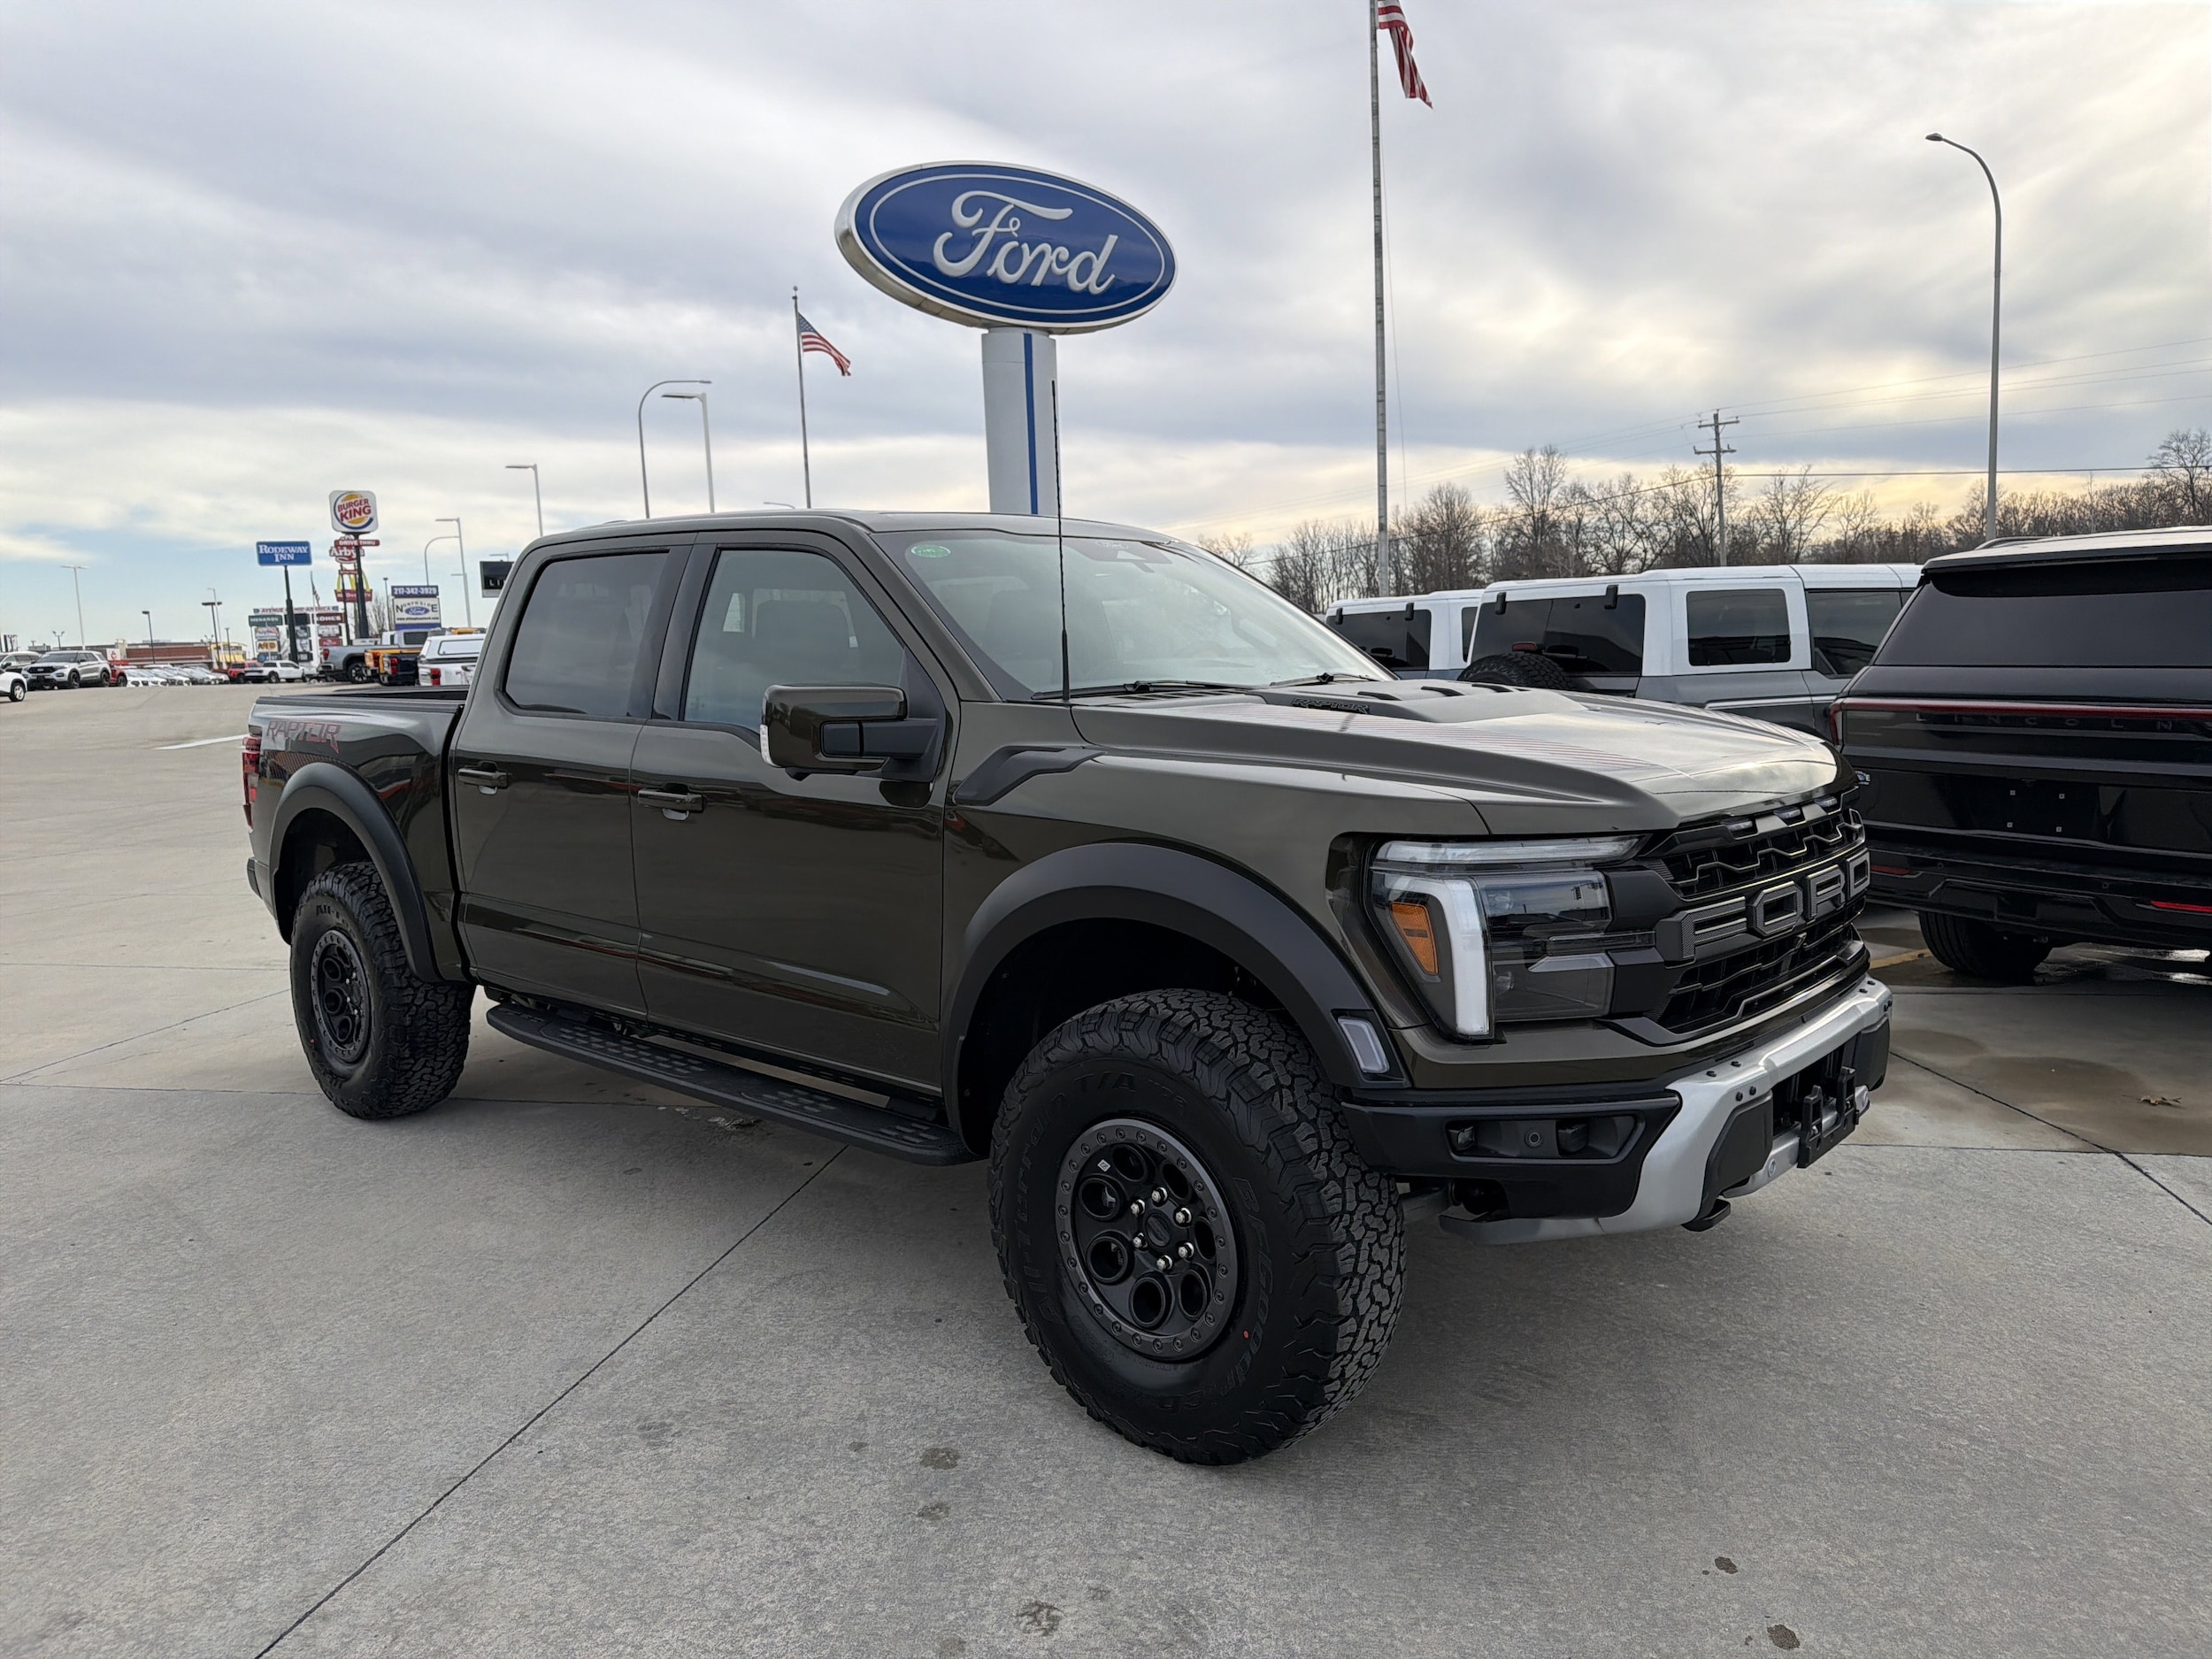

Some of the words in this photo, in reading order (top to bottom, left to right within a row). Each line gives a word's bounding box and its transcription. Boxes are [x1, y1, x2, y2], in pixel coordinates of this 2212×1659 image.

[933, 189, 1119, 296] Ford
[337, 498, 370, 512] BURGER
[339, 505, 372, 522] KING
[257, 544, 309, 554] RODEWAY
[330, 546, 365, 558] Arbys
[274, 553, 295, 563] INN
[1293, 698, 1368, 714] RAPTOR
[266, 720, 342, 754] RAPTOR
[1680, 847, 1870, 960] FORD
